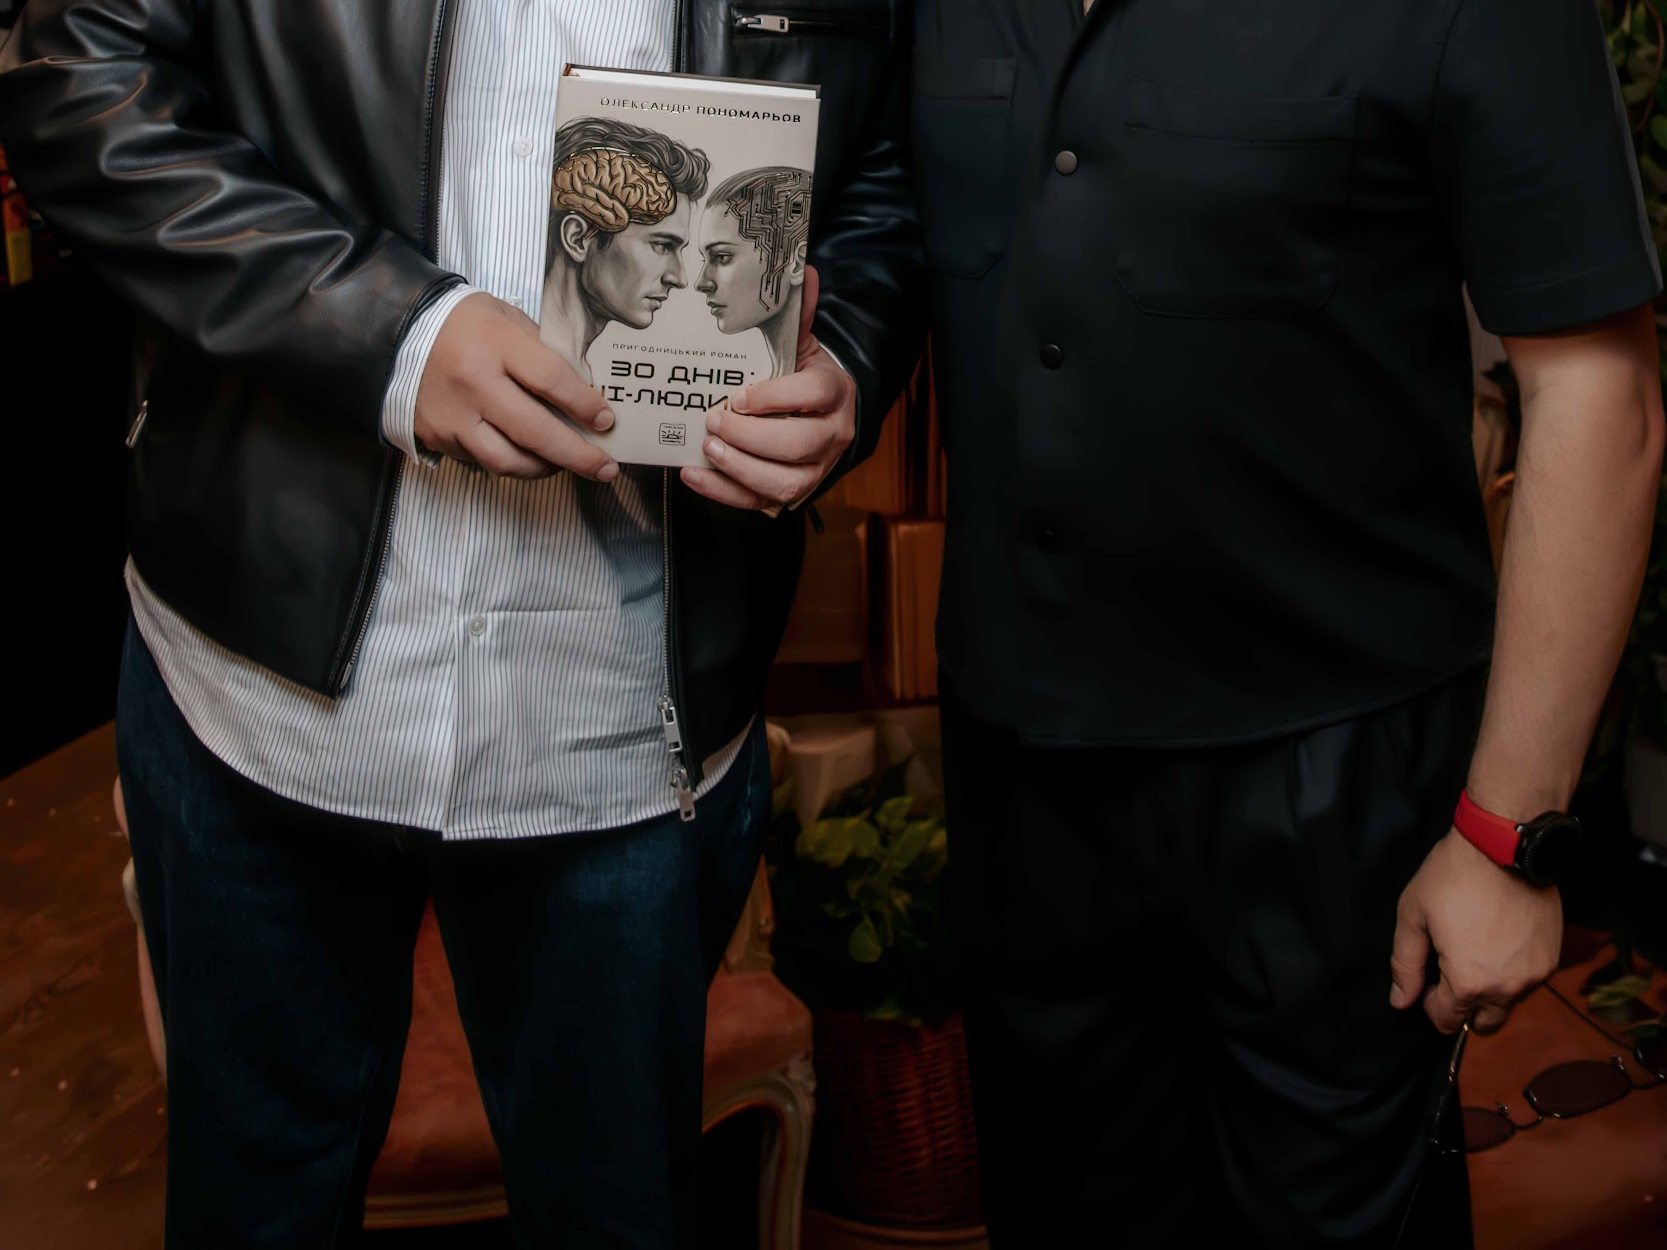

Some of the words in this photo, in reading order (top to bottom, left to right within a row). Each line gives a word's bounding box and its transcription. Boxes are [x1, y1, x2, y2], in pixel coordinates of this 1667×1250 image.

[600, 97, 690, 114] ОЛЕКСАНДР
[696, 105, 801, 123] ПОНОМАРЬОВ
[612, 343, 706, 357] ПРИГОДНИЦЬКИЙ
[710, 351, 747, 359] РОМАН
[610, 360, 655, 379] 30
